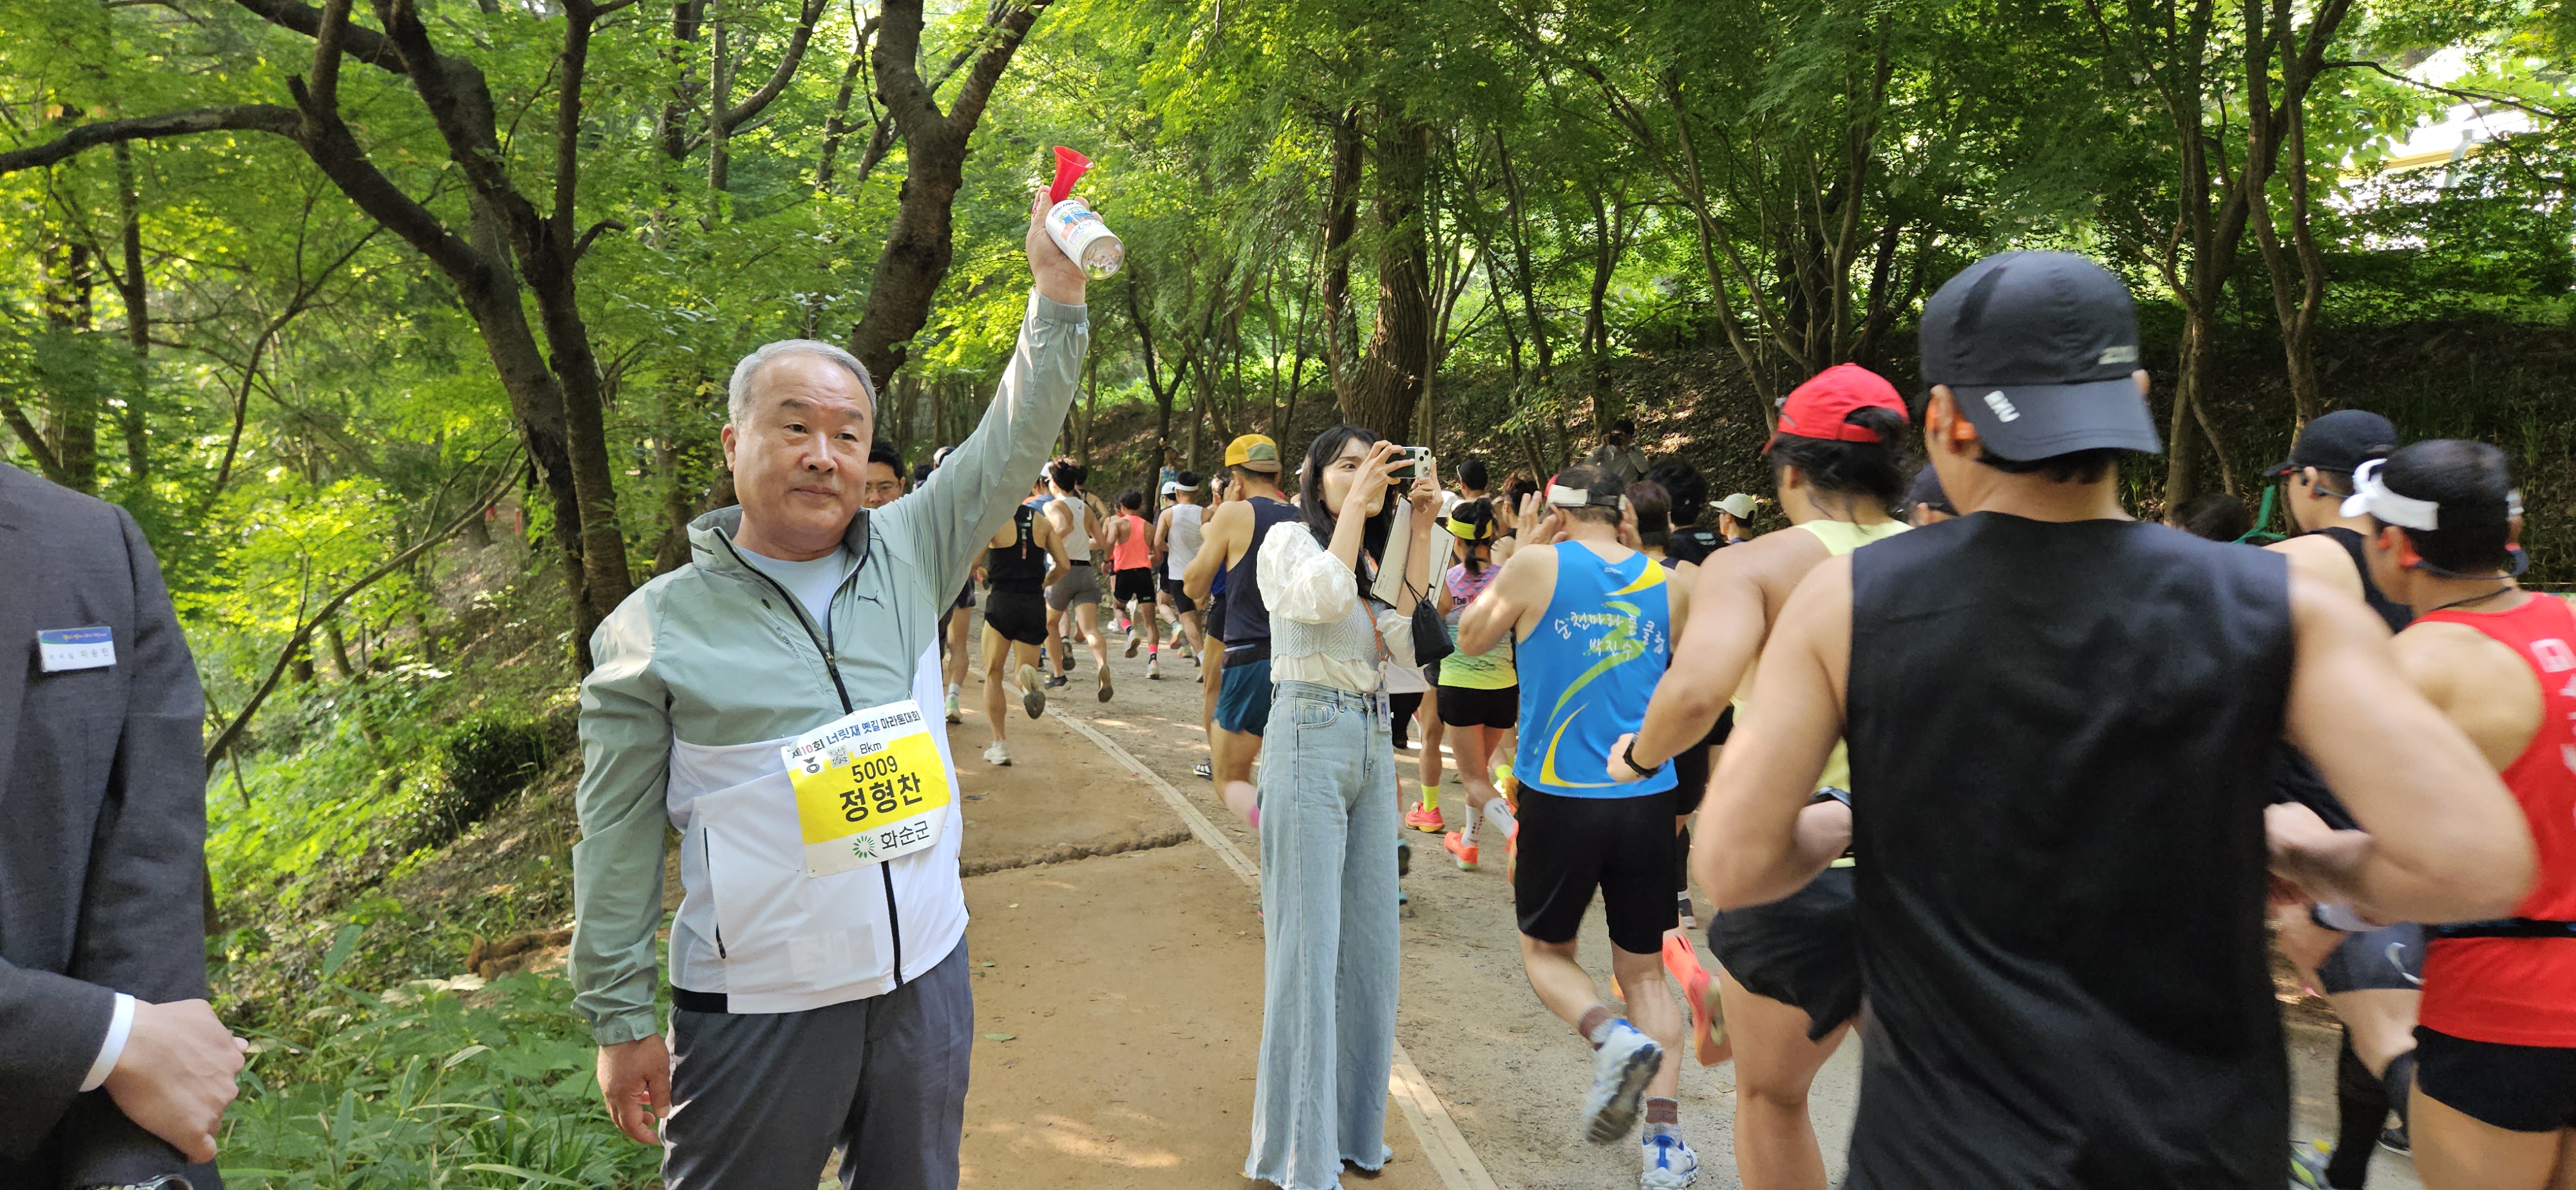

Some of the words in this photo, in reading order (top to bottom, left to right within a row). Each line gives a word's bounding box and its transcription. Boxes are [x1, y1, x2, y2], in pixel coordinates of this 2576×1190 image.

[1452, 596, 1466, 605] The
[791, 739, 826, 759] 제10회
[826, 724, 861, 745] 너릿재
[862, 719, 881, 734] 옛길
[880, 710, 922, 729] 마라톤대회
[859, 742, 882, 754] 8km
[851, 755, 898, 783] 5009
[839, 771, 923, 822] 정형찬
[880, 820, 930, 849] 화순군
